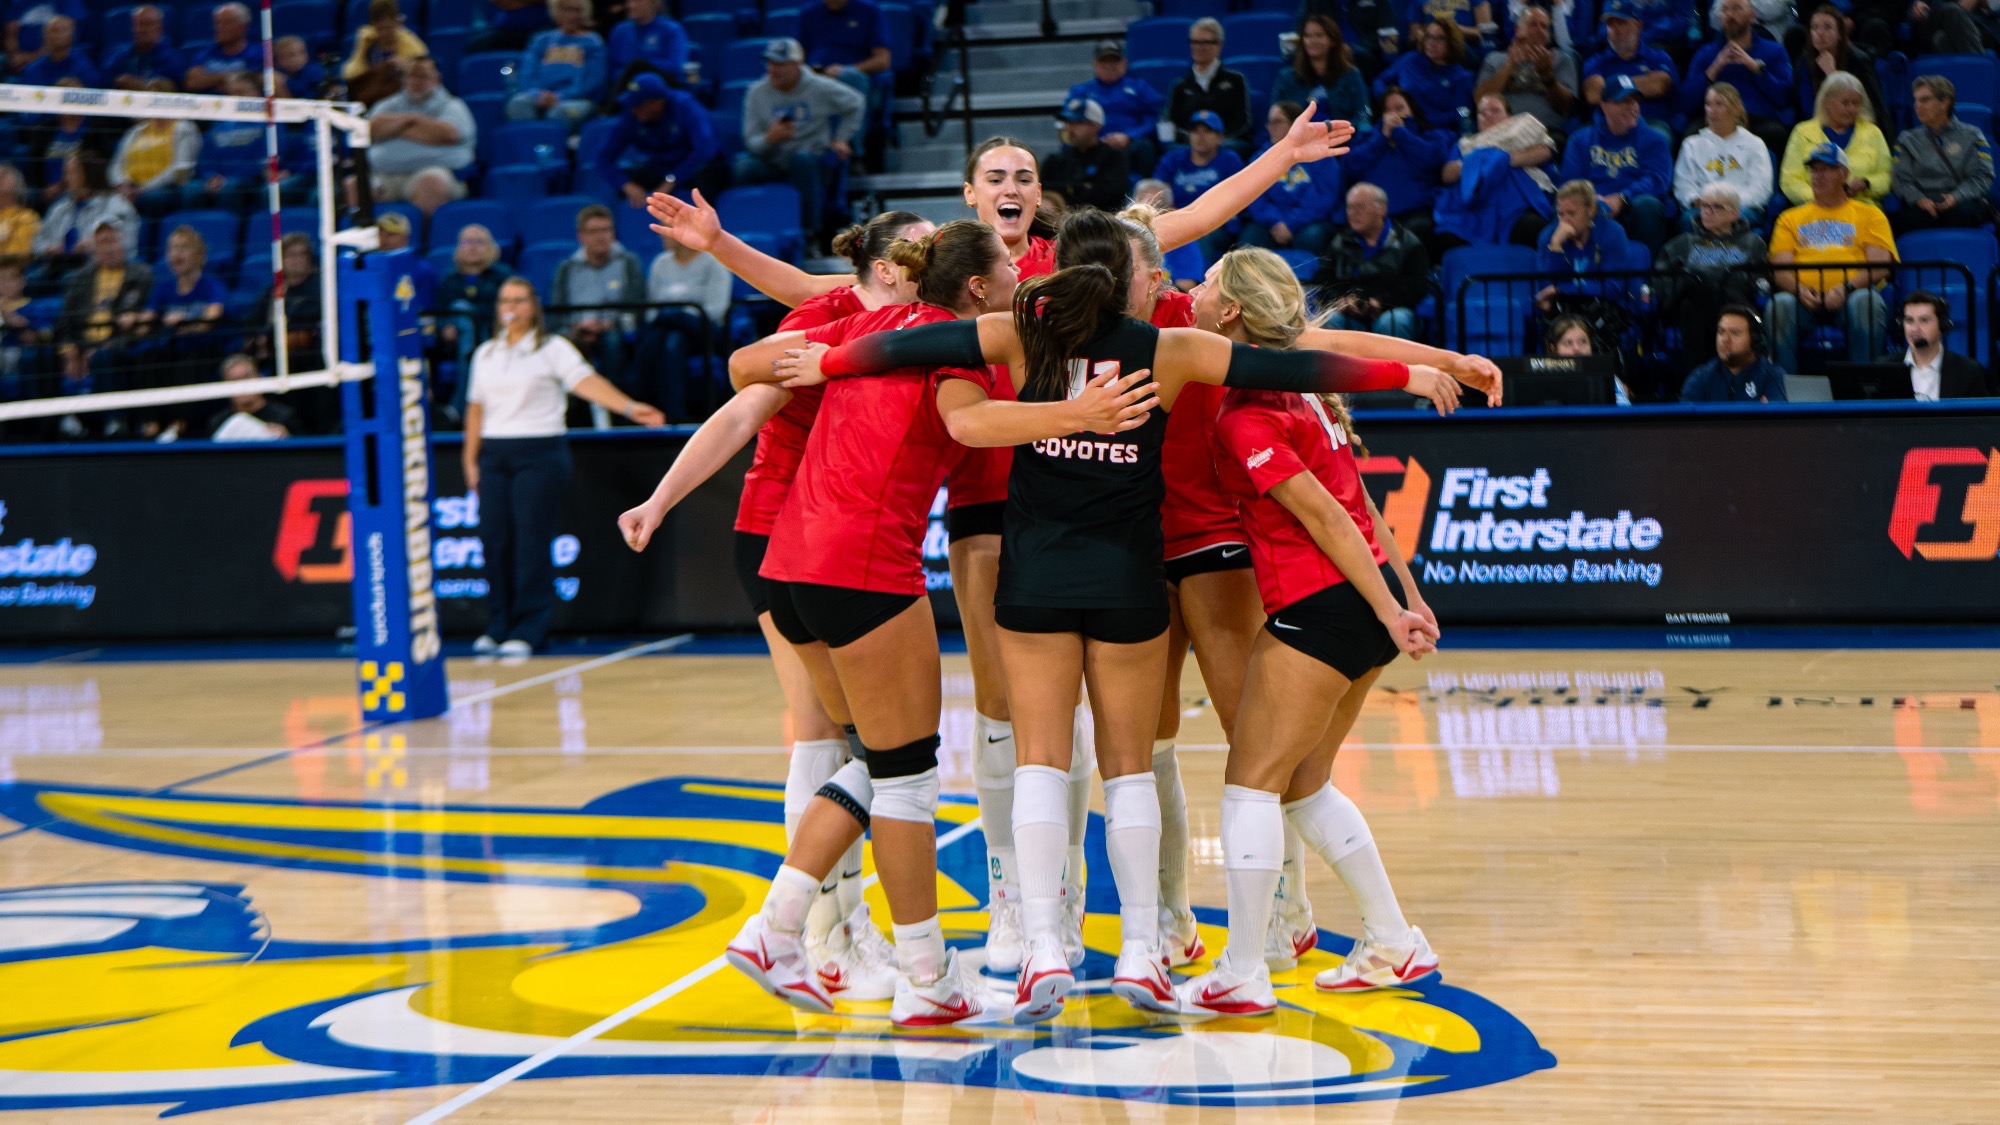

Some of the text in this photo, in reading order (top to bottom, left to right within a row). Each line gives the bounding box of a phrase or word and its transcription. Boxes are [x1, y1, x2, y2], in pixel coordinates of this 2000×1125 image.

[1032, 437, 1139, 464] COYOTES
[1438, 467, 1552, 509] First
[398, 356, 442, 664] JACKRABBITS
[1430, 509, 1663, 552] Interstate
[0, 537, 97, 577] state
[1423, 558, 1663, 587] No Nonsense Banking
[1665, 612, 1731, 624] DAKTRONICS
